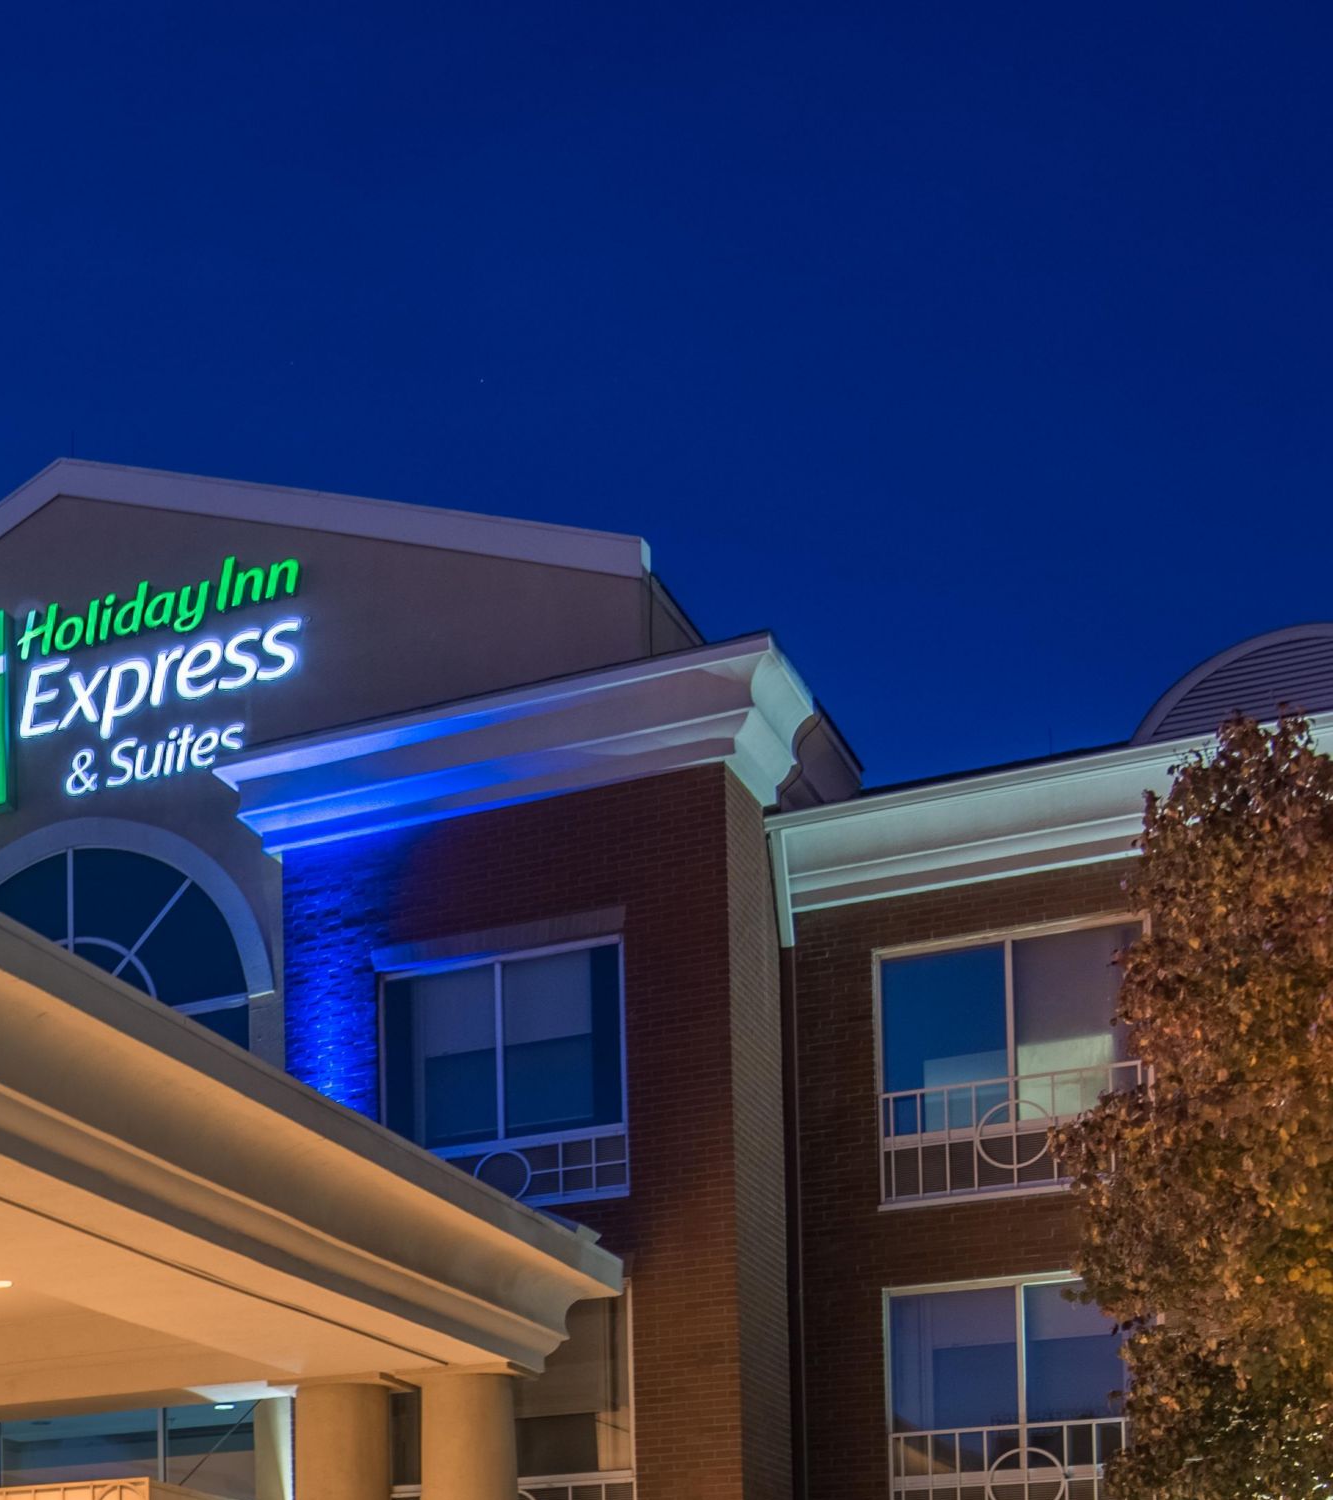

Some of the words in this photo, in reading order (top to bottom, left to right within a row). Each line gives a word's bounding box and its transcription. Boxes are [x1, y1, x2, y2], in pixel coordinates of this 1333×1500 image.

[18, 580, 210, 660] Holiday
[217, 555, 300, 612] Inn
[19, 617, 302, 739] Express
[66, 748, 98, 796] &
[106, 723, 245, 787] Suites
